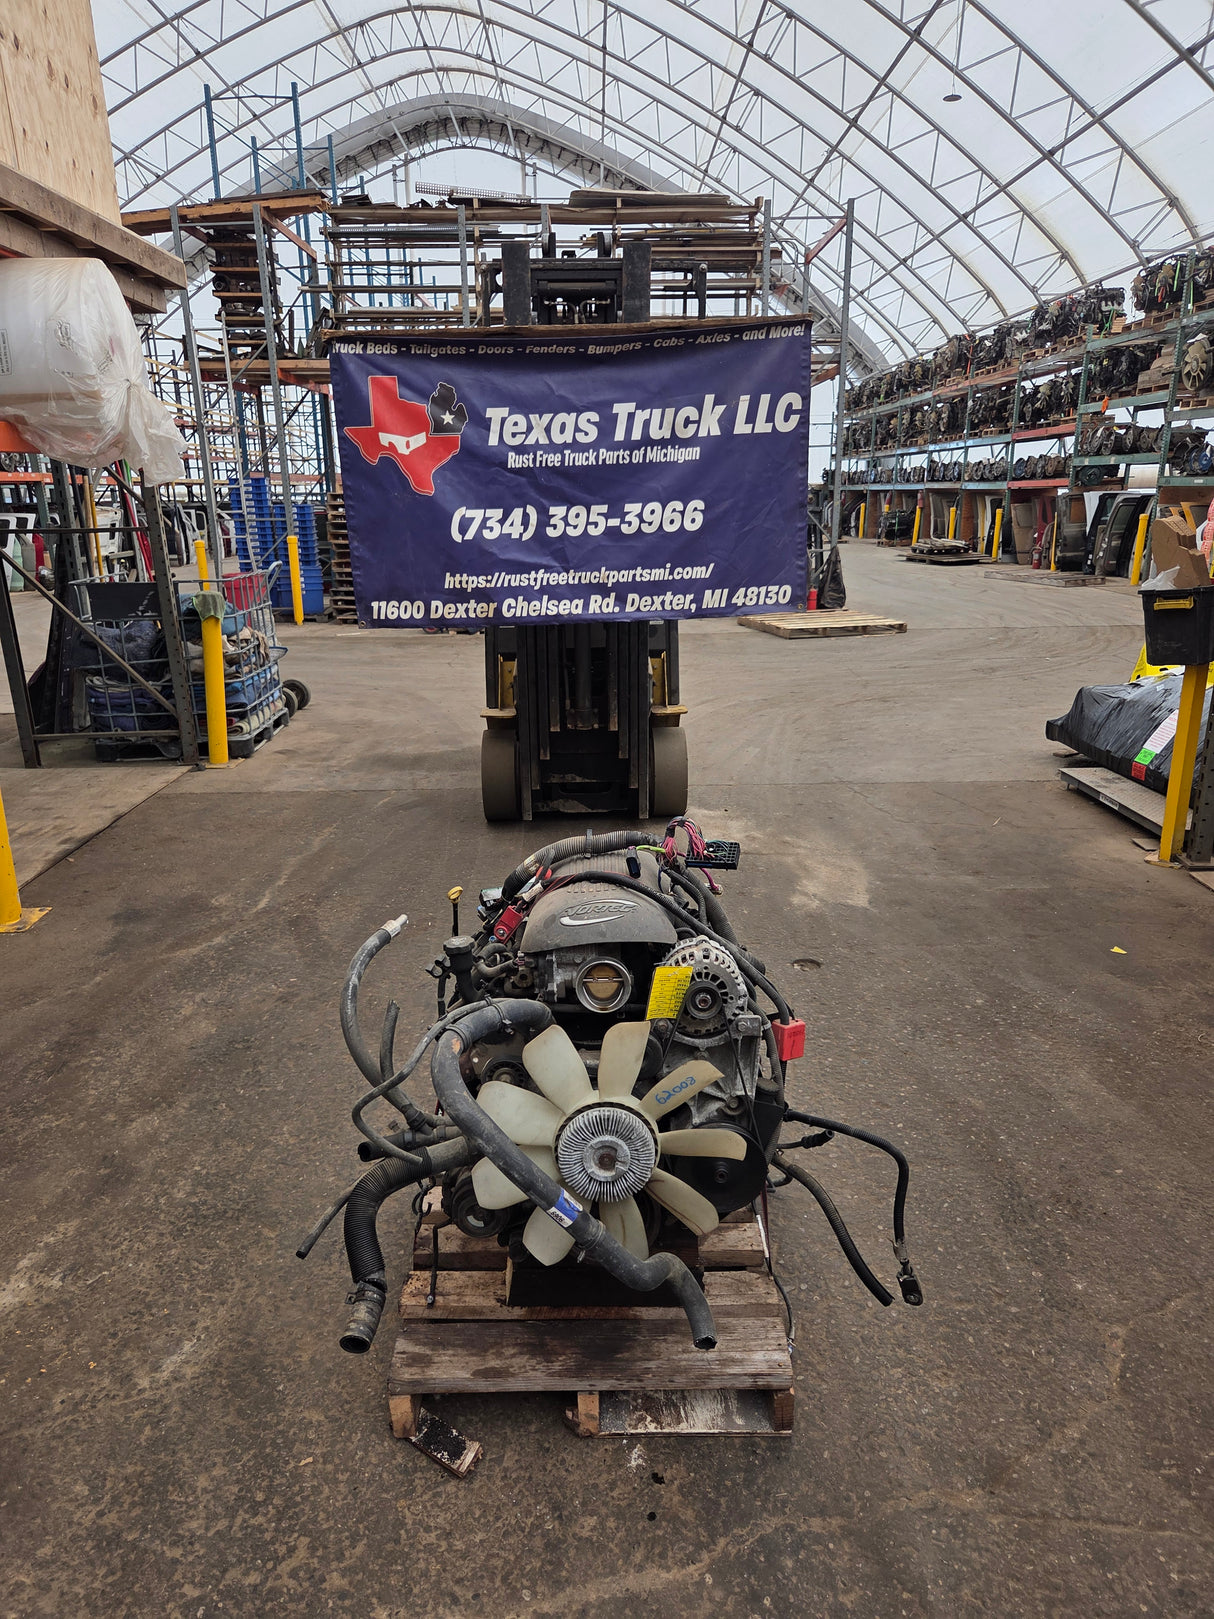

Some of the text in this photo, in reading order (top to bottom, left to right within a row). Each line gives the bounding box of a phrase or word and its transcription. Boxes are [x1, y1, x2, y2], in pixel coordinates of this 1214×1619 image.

[366, 342, 398, 354] Beds
[409, 344, 466, 358] Tailgates
[477, 344, 514, 354] Doors
[525, 345, 576, 354] Fenders
[587, 341, 642, 355] Bumpers
[653, 337, 685, 348] Cabs
[695, 332, 731, 345] Axles
[742, 327, 766, 340] and
[768, 324, 805, 339] More!
[485, 391, 803, 446] Texas Truck LLC
[507, 445, 701, 469] Rust Free Truck Parts of Michigan
[450, 499, 706, 543] (734) 395-3966
[444, 562, 715, 592] https://rustfreetruckpartsmi.com/
[371, 585, 792, 620] 11600 Dexter Chelsea Rd. Dexter, MI 48130
